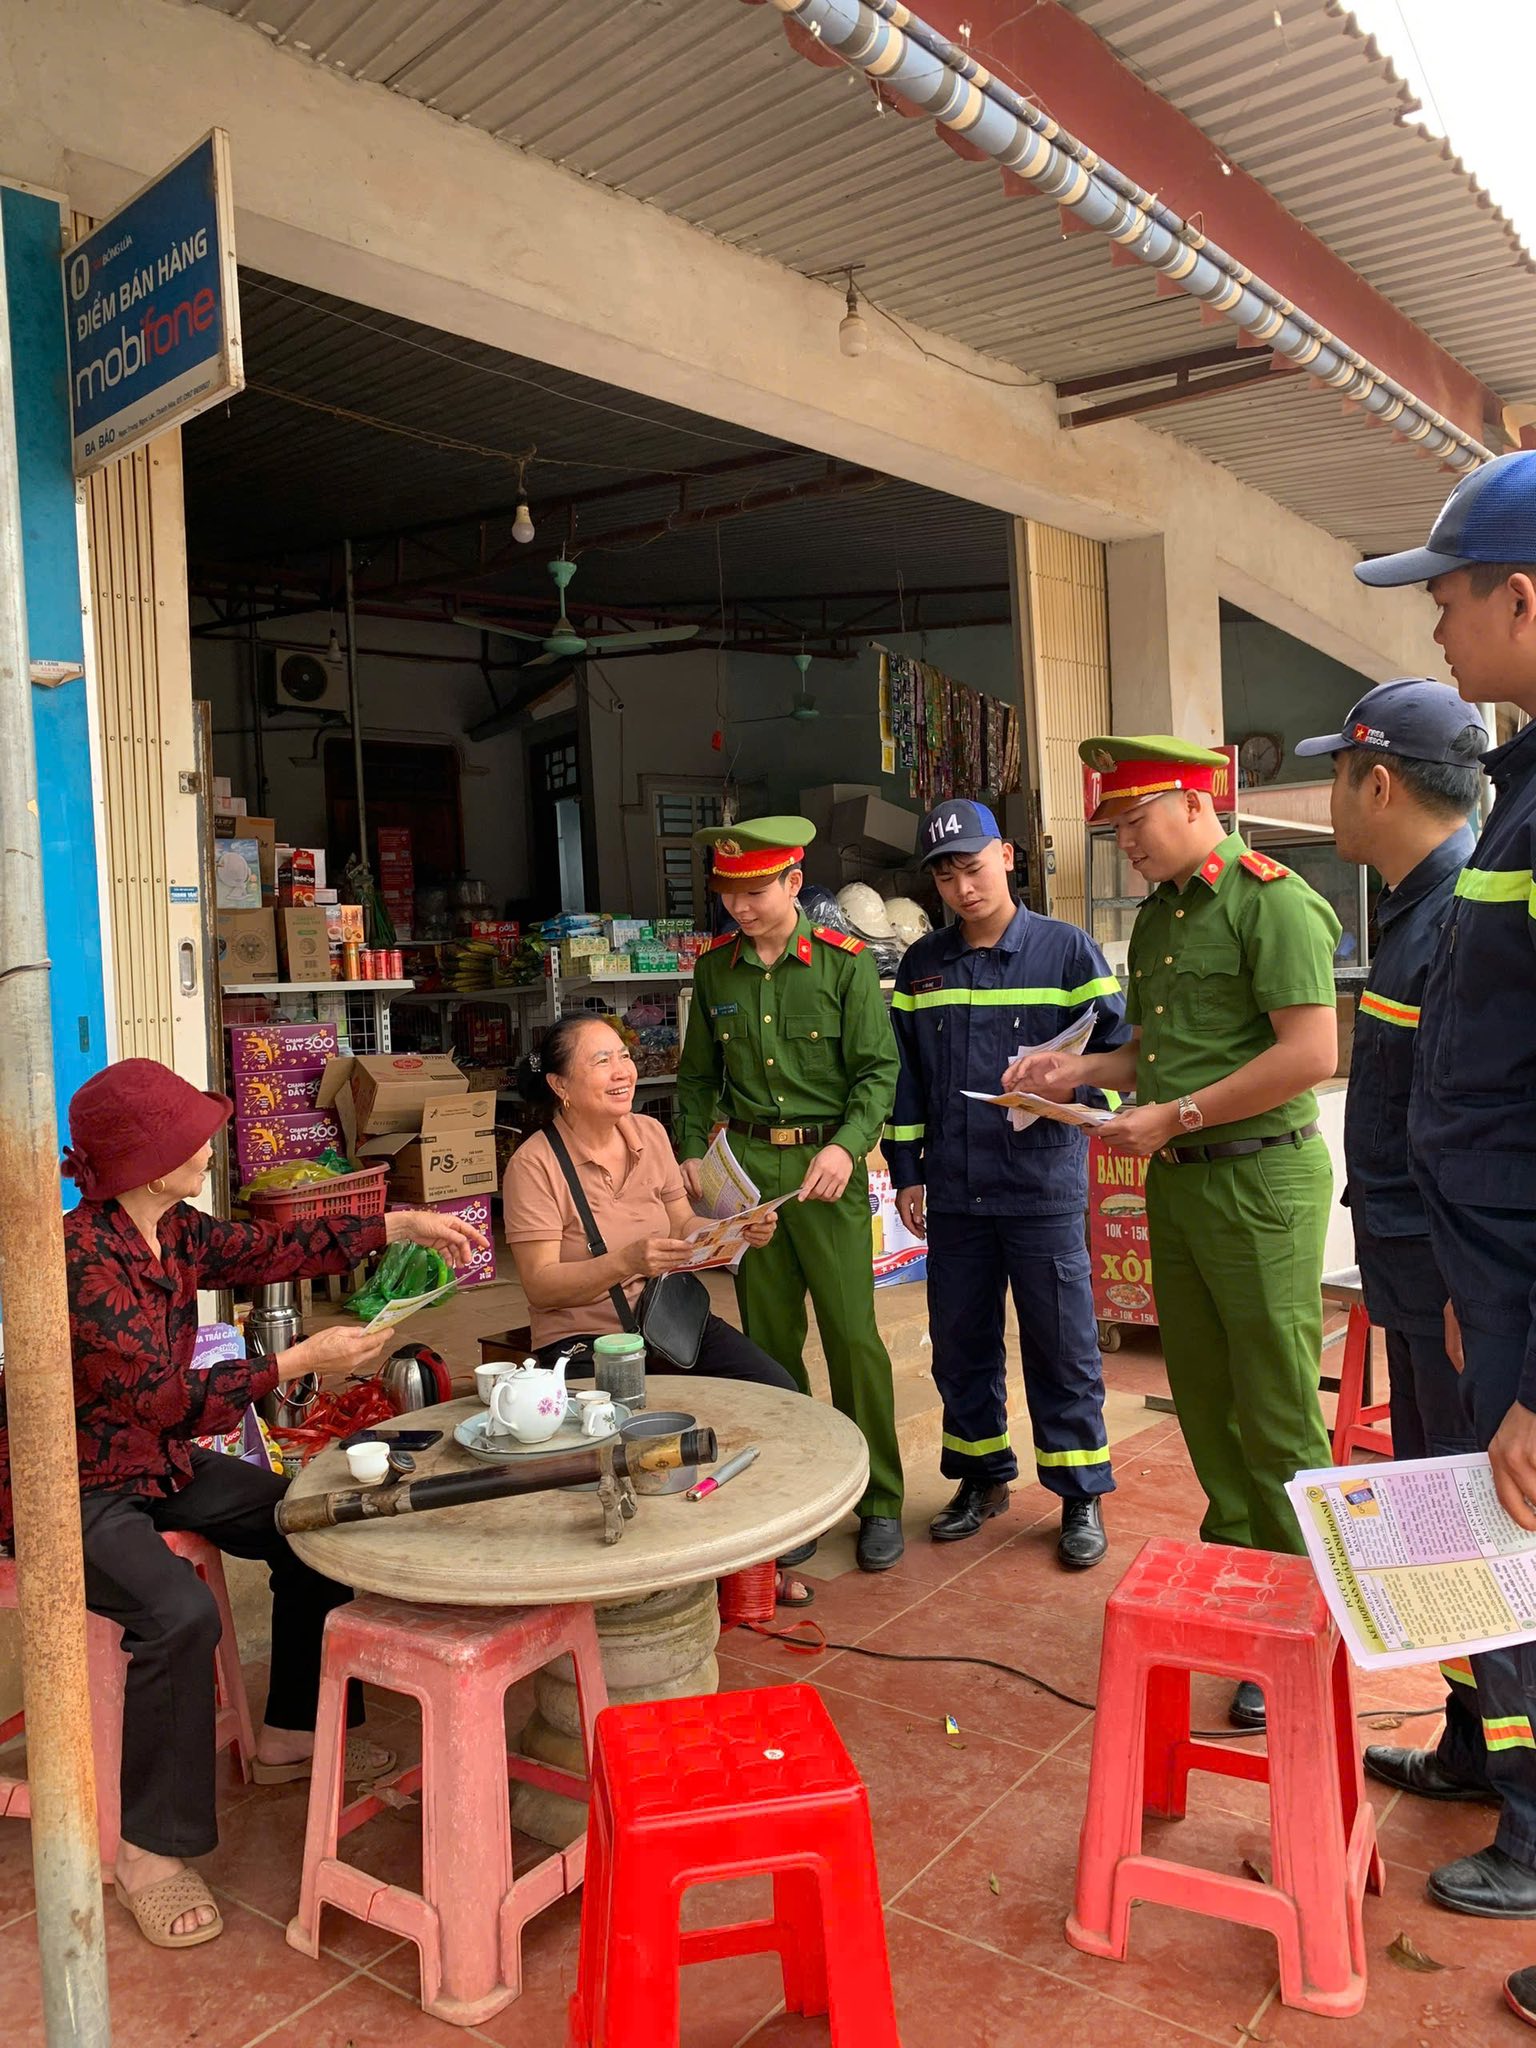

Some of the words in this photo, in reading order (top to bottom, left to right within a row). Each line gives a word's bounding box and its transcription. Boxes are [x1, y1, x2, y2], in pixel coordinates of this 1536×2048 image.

[77, 291, 116, 342] ĐIỂM
[119, 267, 154, 313] BÁN
[157, 227, 208, 287] HÀNG
[76, 287, 215, 408] mobifone
[84, 442, 96, 457] BA
[928, 813, 963, 844] 114
[286, 1043, 304, 1052] DÂY
[1097, 1147, 1134, 1187] BÁNH
[1105, 1223, 1122, 1239] 10K
[1131, 1225, 1149, 1241] 15K
[1119, 1309, 1133, 1320] 10K
[1140, 1312, 1154, 1323] 15K
[205, 1330, 222, 1342] TRÁI
[222, 1328, 238, 1338] CÂY
[1320, 1501, 1337, 1531] DOANH
[1332, 1535, 1345, 1556] KINH
[1325, 1547, 1338, 1566] NHÀ
[1339, 1585, 1353, 1607] PCCC
[1351, 1588, 1362, 1603] SẢN
[1357, 1606, 1370, 1621] HỢP
[1365, 1624, 1379, 1639] KẾT
